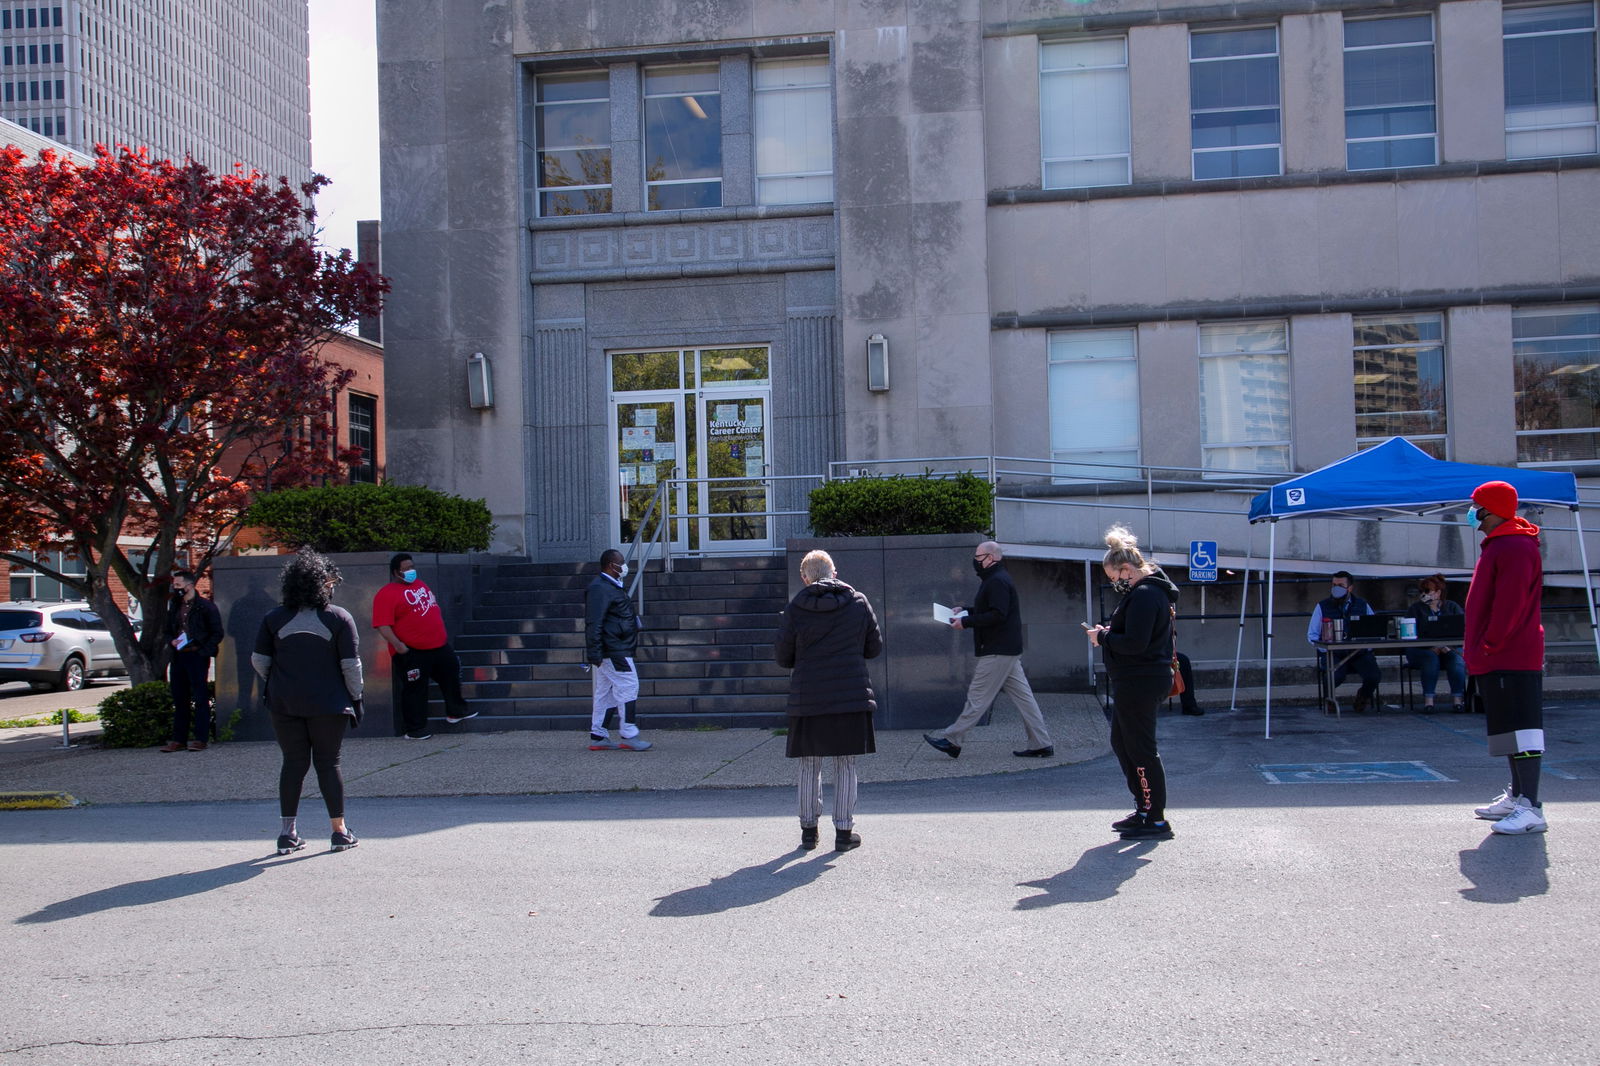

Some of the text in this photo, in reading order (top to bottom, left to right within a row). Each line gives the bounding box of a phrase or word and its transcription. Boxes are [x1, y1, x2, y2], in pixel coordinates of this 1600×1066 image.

[709, 420, 746, 428] Kentucky
[710, 426, 762, 435] Career Center
[1191, 571, 1216, 579] PARKING
